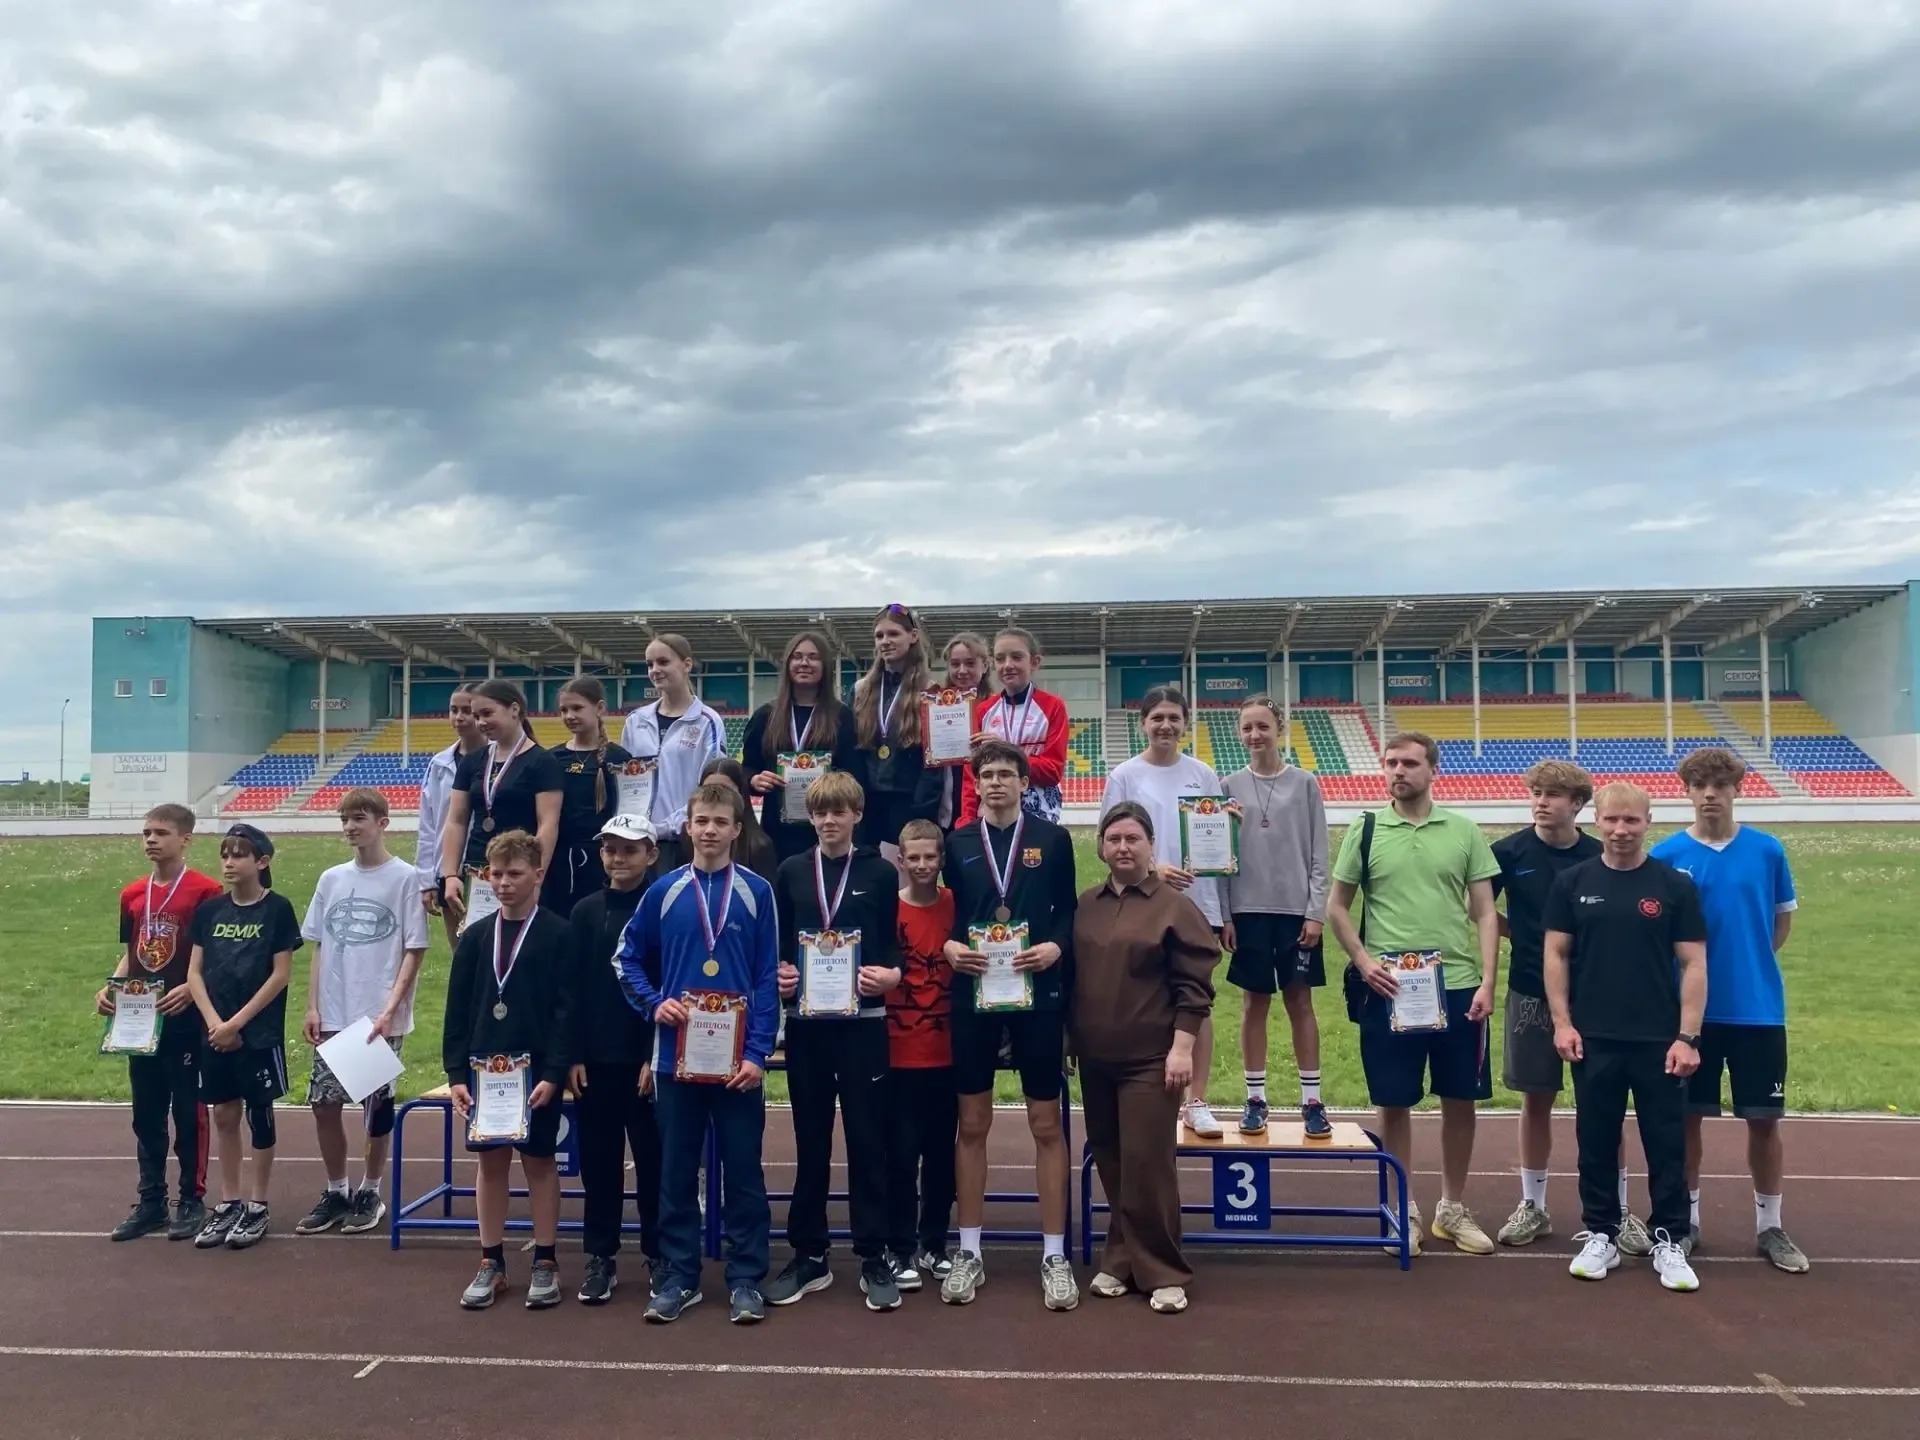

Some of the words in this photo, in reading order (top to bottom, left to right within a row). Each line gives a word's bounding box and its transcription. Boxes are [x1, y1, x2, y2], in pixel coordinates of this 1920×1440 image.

[1207, 680, 1237, 688] СЕКТОР
[1389, 678, 1419, 686] СЕКТОР
[311, 701, 340, 709] СЕТОР
[935, 712, 966, 721] ДИПЛОМ
[118, 755, 163, 763] ЗАПАДНАЯ
[122, 765, 159, 773] ТРИБУНА
[1193, 822, 1225, 830] ДИПЛОМ
[212, 923, 264, 939] DEMIX
[812, 957, 848, 966] ДИПЛОМ
[693, 1021, 731, 1030] ДИПЛОМ
[183, 1052, 192, 1066] 2
[485, 1082, 519, 1090] ДИПЛОМ
[1226, 1161, 1258, 1209] 3
